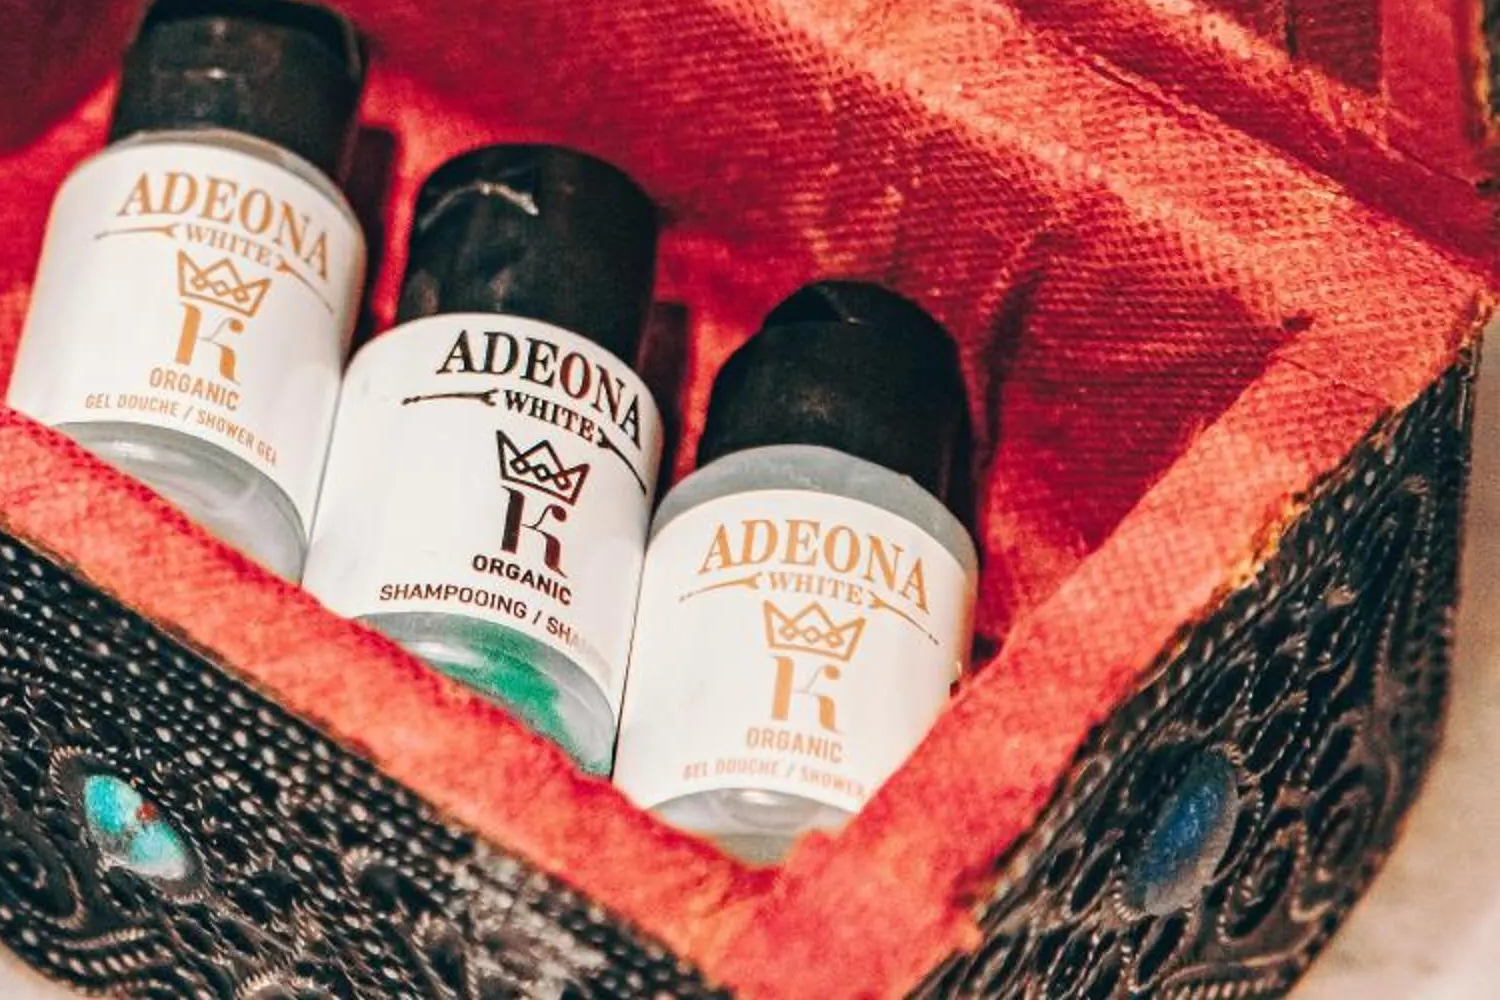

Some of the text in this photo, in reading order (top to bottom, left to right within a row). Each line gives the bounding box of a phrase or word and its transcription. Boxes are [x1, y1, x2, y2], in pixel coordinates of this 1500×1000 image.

[116, 171, 329, 281] ADEONA
[185, 223, 272, 267] WHITE
[149, 367, 240, 411] ORGANIC
[436, 329, 641, 450] ADEONA
[85, 393, 110, 409] GEL
[117, 394, 178, 417] DOUCHE
[196, 409, 255, 449] SHOWER
[503, 389, 594, 443] WHITE
[472, 554, 573, 606] ORGANIC
[697, 519, 930, 615] ADEONA
[766, 571, 864, 605] WHITE
[379, 583, 527, 619] SHAMPOOING
[715, 757, 779, 777] DOUCHE
[746, 727, 843, 764] ORGANIC
